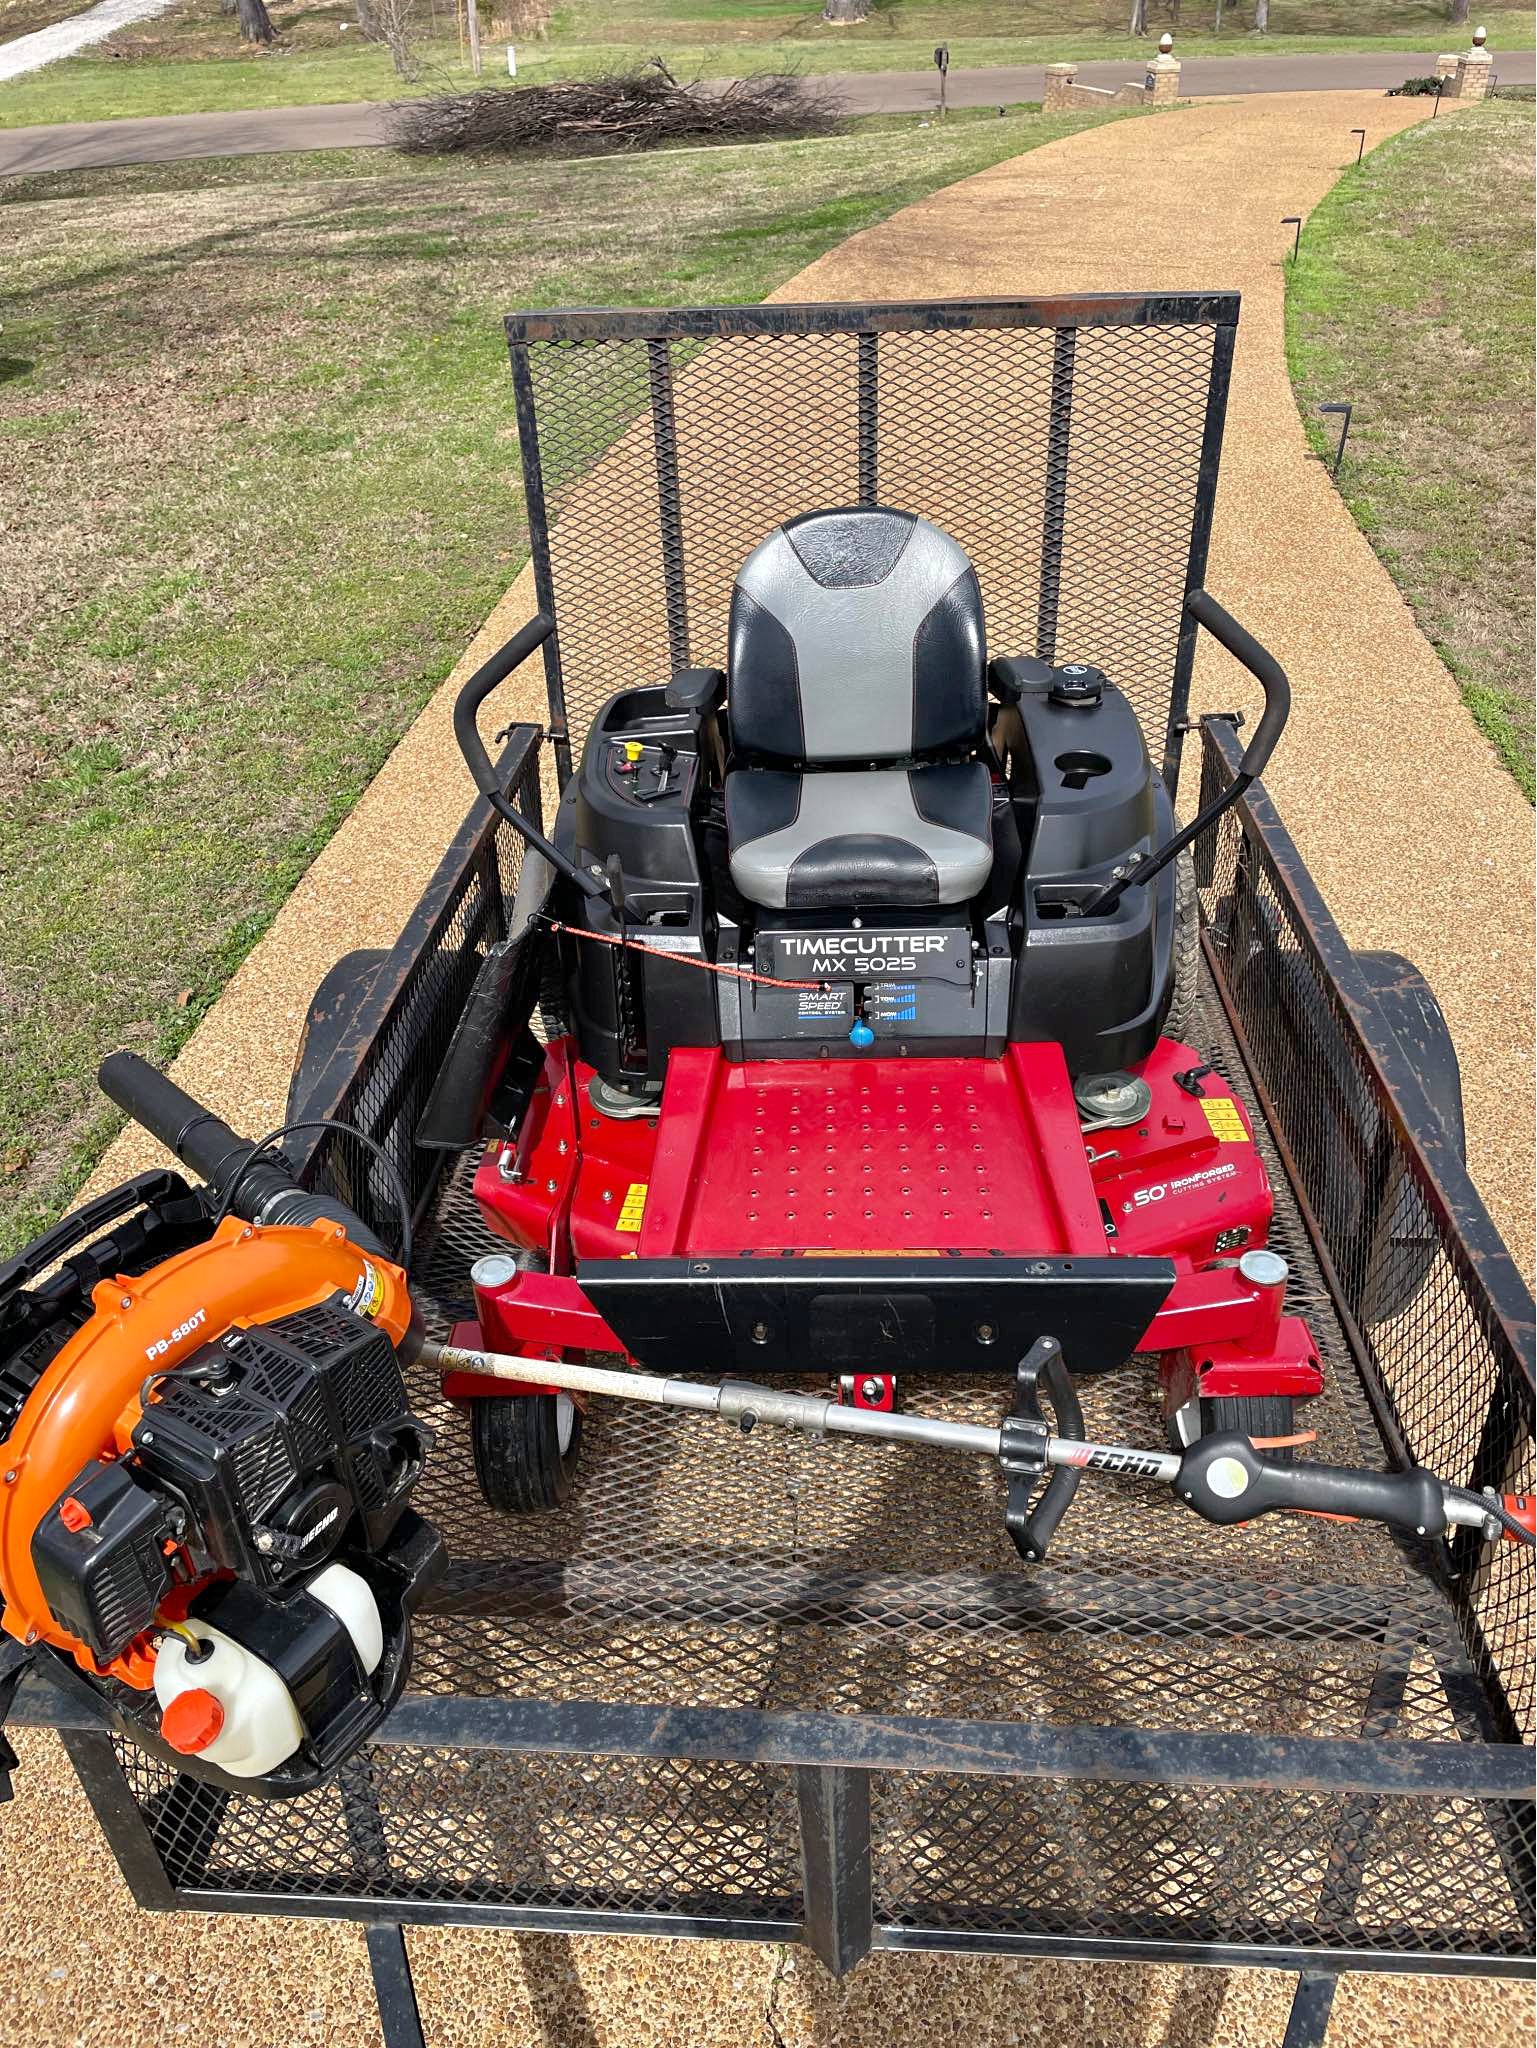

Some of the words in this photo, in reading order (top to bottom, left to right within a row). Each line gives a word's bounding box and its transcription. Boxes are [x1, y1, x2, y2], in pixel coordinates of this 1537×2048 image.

[780, 935, 946, 955] TIMECUTTER
[812, 958, 847, 973] MX
[854, 956, 917, 972] 5025
[798, 992, 847, 1001] SMART
[798, 1002, 842, 1010] SPEED
[1172, 1180, 1205, 1195] CUTTING
[1206, 1170, 1238, 1185] SYSTEM
[144, 1307, 206, 1361] PB-580T
[1086, 1450, 1162, 1477] ECHO
[308, 1506, 339, 1543] ECHO
